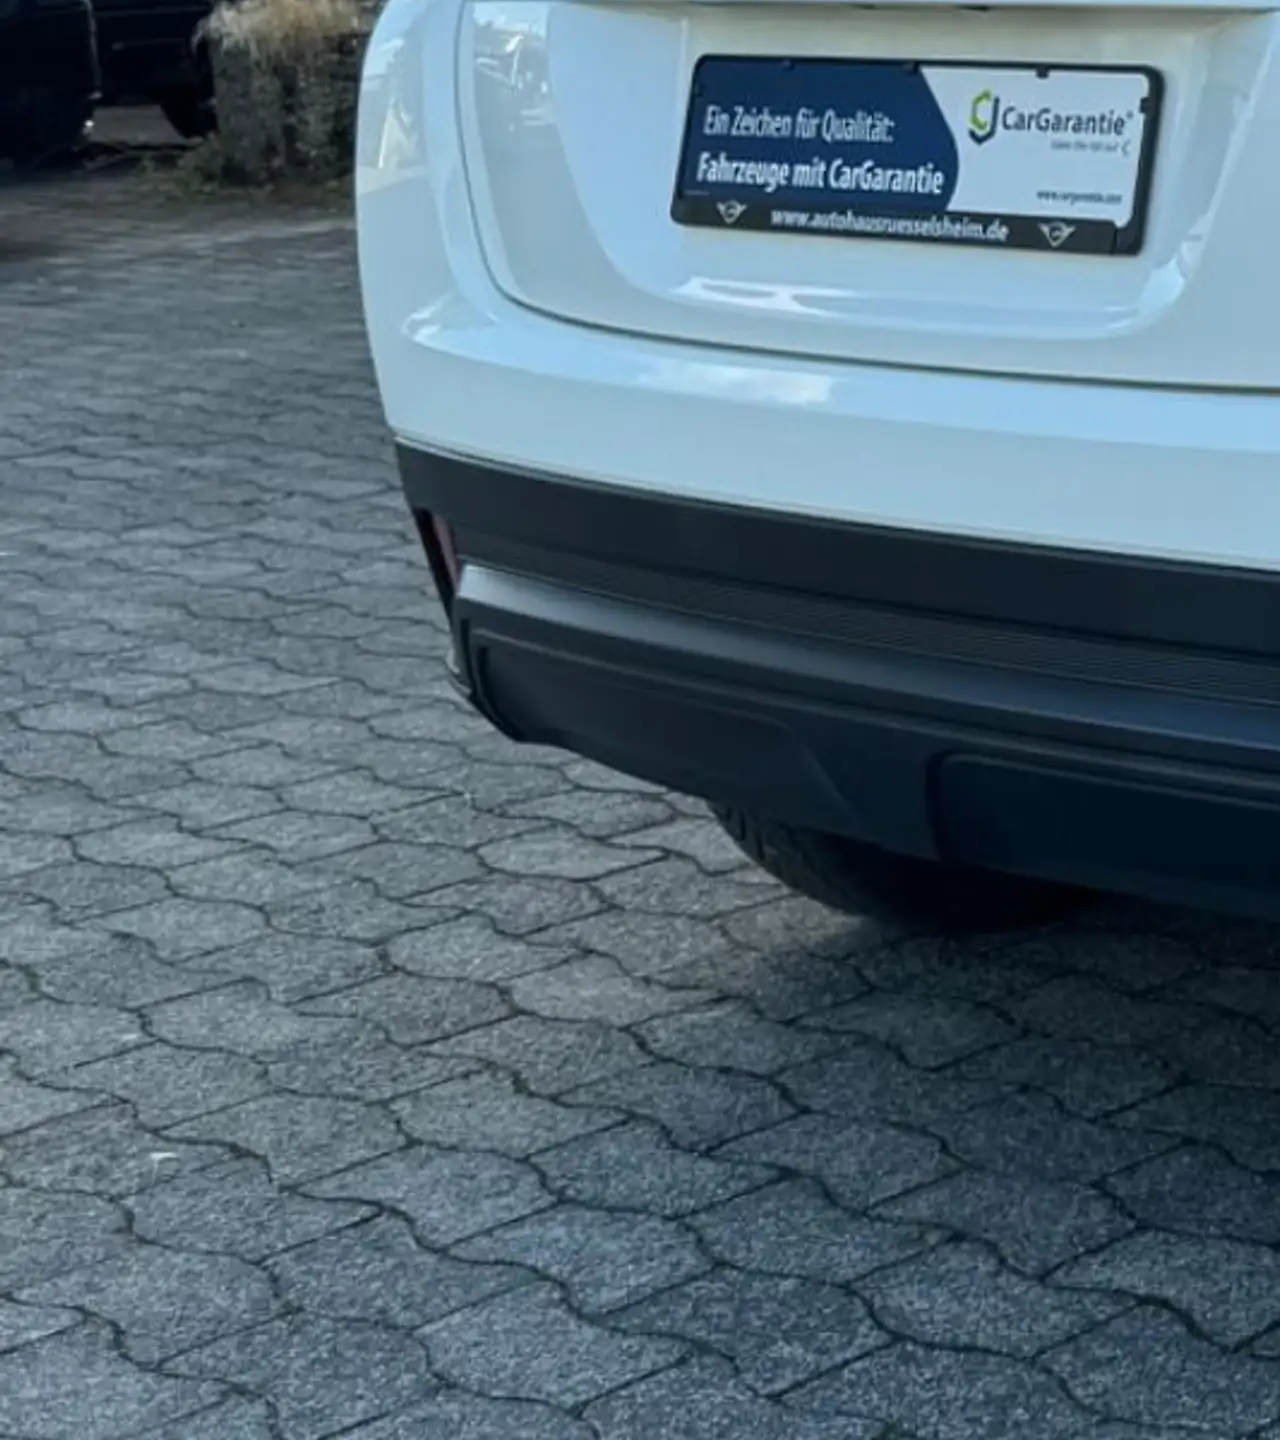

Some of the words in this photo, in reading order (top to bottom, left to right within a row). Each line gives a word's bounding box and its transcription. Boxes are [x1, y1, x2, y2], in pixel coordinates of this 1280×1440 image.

[703, 104, 730, 135] Ein
[730, 104, 792, 137] Zeichen
[795, 106, 821, 139] für
[822, 108, 895, 143] Qualität:
[696, 152, 790, 193] Fahrzeuge
[792, 157, 826, 188] mit
[828, 159, 944, 195] CarGarantie
[770, 209, 1009, 241] www.autohausruesselsheim.de
